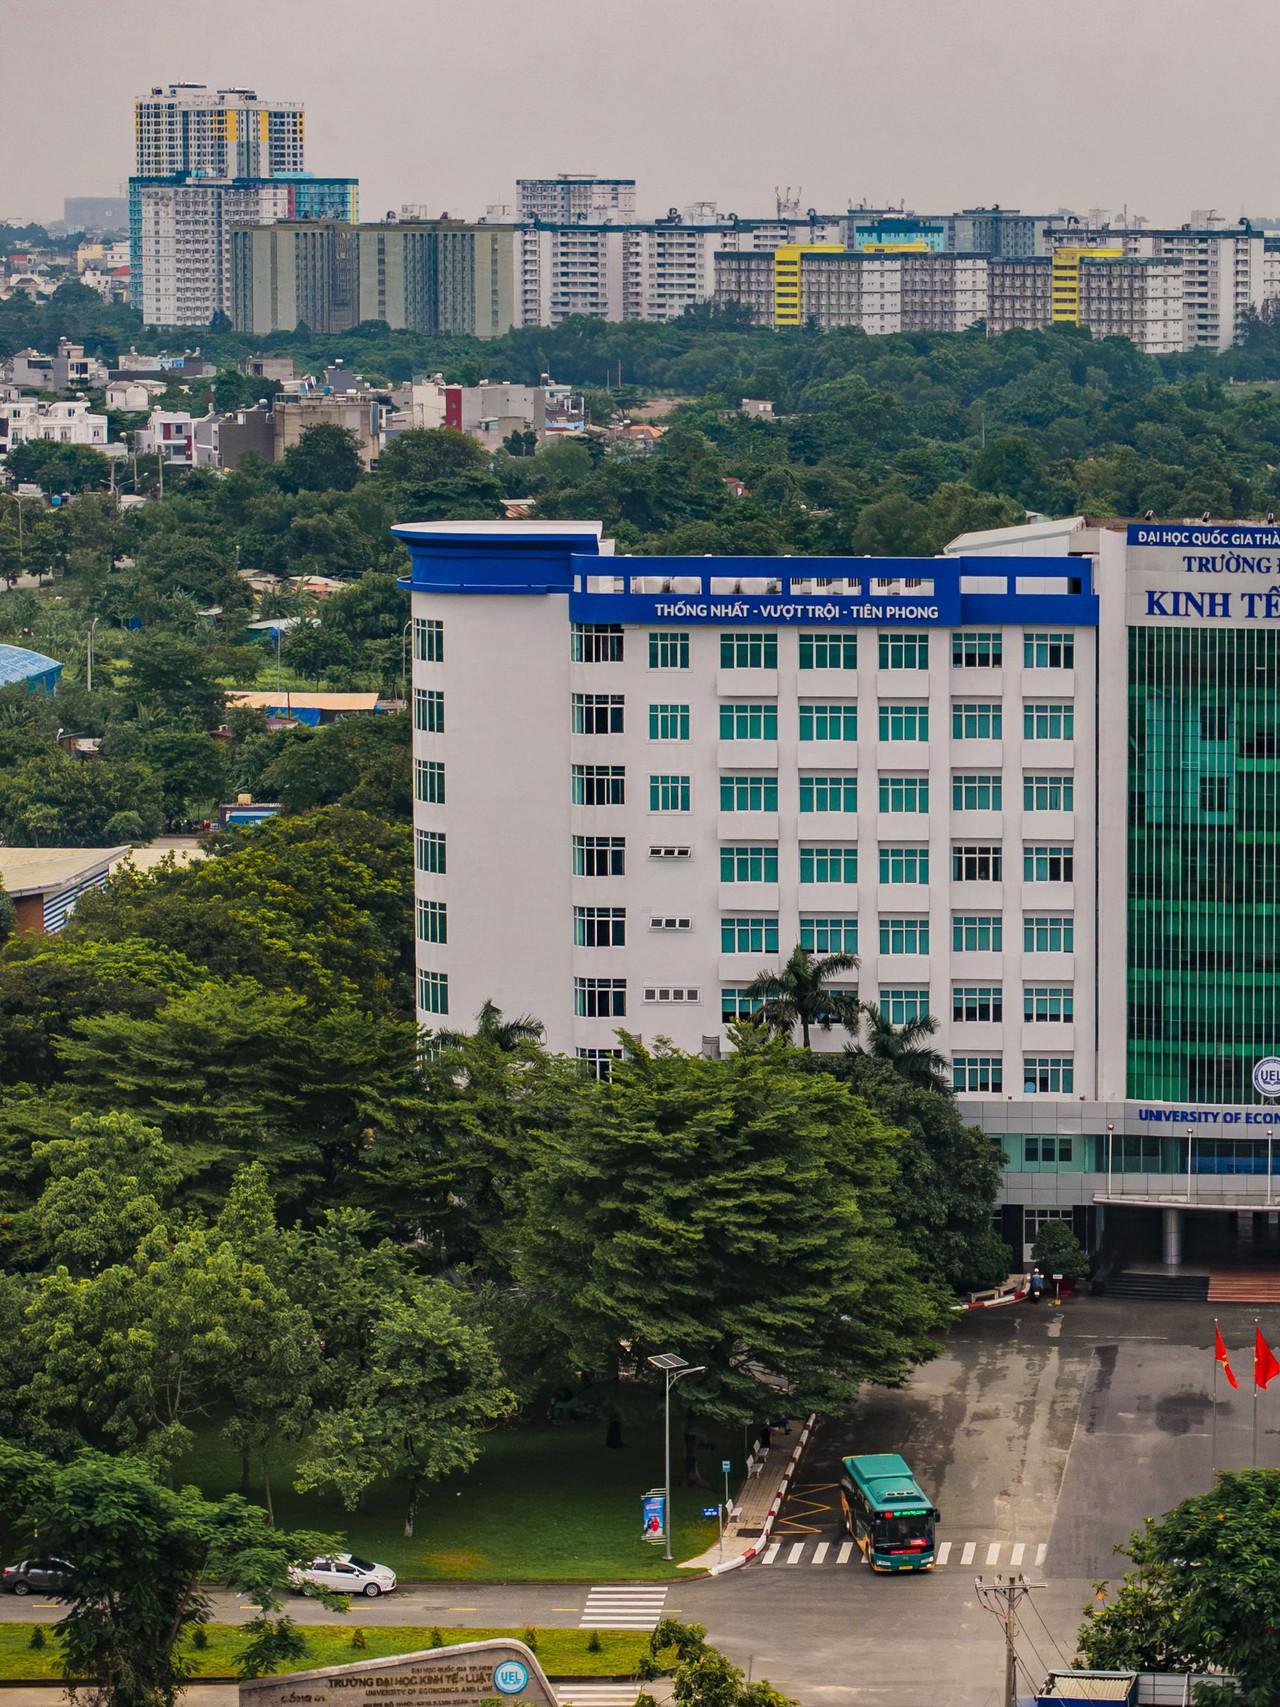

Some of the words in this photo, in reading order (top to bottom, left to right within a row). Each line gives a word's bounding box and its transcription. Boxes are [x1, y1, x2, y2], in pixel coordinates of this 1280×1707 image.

[1138, 531, 1160, 545] ĐẠI
[1163, 532, 1189, 545] HỌC
[1192, 529, 1229, 545] QUỐC
[1231, 534, 1253, 545] GIA
[1183, 551, 1271, 574] TRƯỜNG
[655, 600, 707, 617] THỐNG
[710, 601, 750, 617] NHẤT
[760, 604, 804, 620] VƯỢT
[806, 603, 839, 620] TRỘI
[850, 603, 882, 618] TIÊN
[886, 606, 938, 619] PHONG
[1144, 590, 1233, 618] KINH
[1138, 1109, 1220, 1123] UNIVERSITY
[1222, 1112, 1242, 1124] OF
[329, 1676, 374, 1688] TRƯỜNG
[375, 1677, 393, 1688] ĐẠI
[395, 1676, 417, 1687] HỌC
[420, 1674, 443, 1685] KINH
[445, 1672, 459, 1685] TẾ
[466, 1672, 492, 1684] LUẬT
[501, 1671, 521, 1681] UEL
[365, 1688, 405, 1697] UNIVERSITY
[418, 1687, 459, 1695] ECONOMICS
